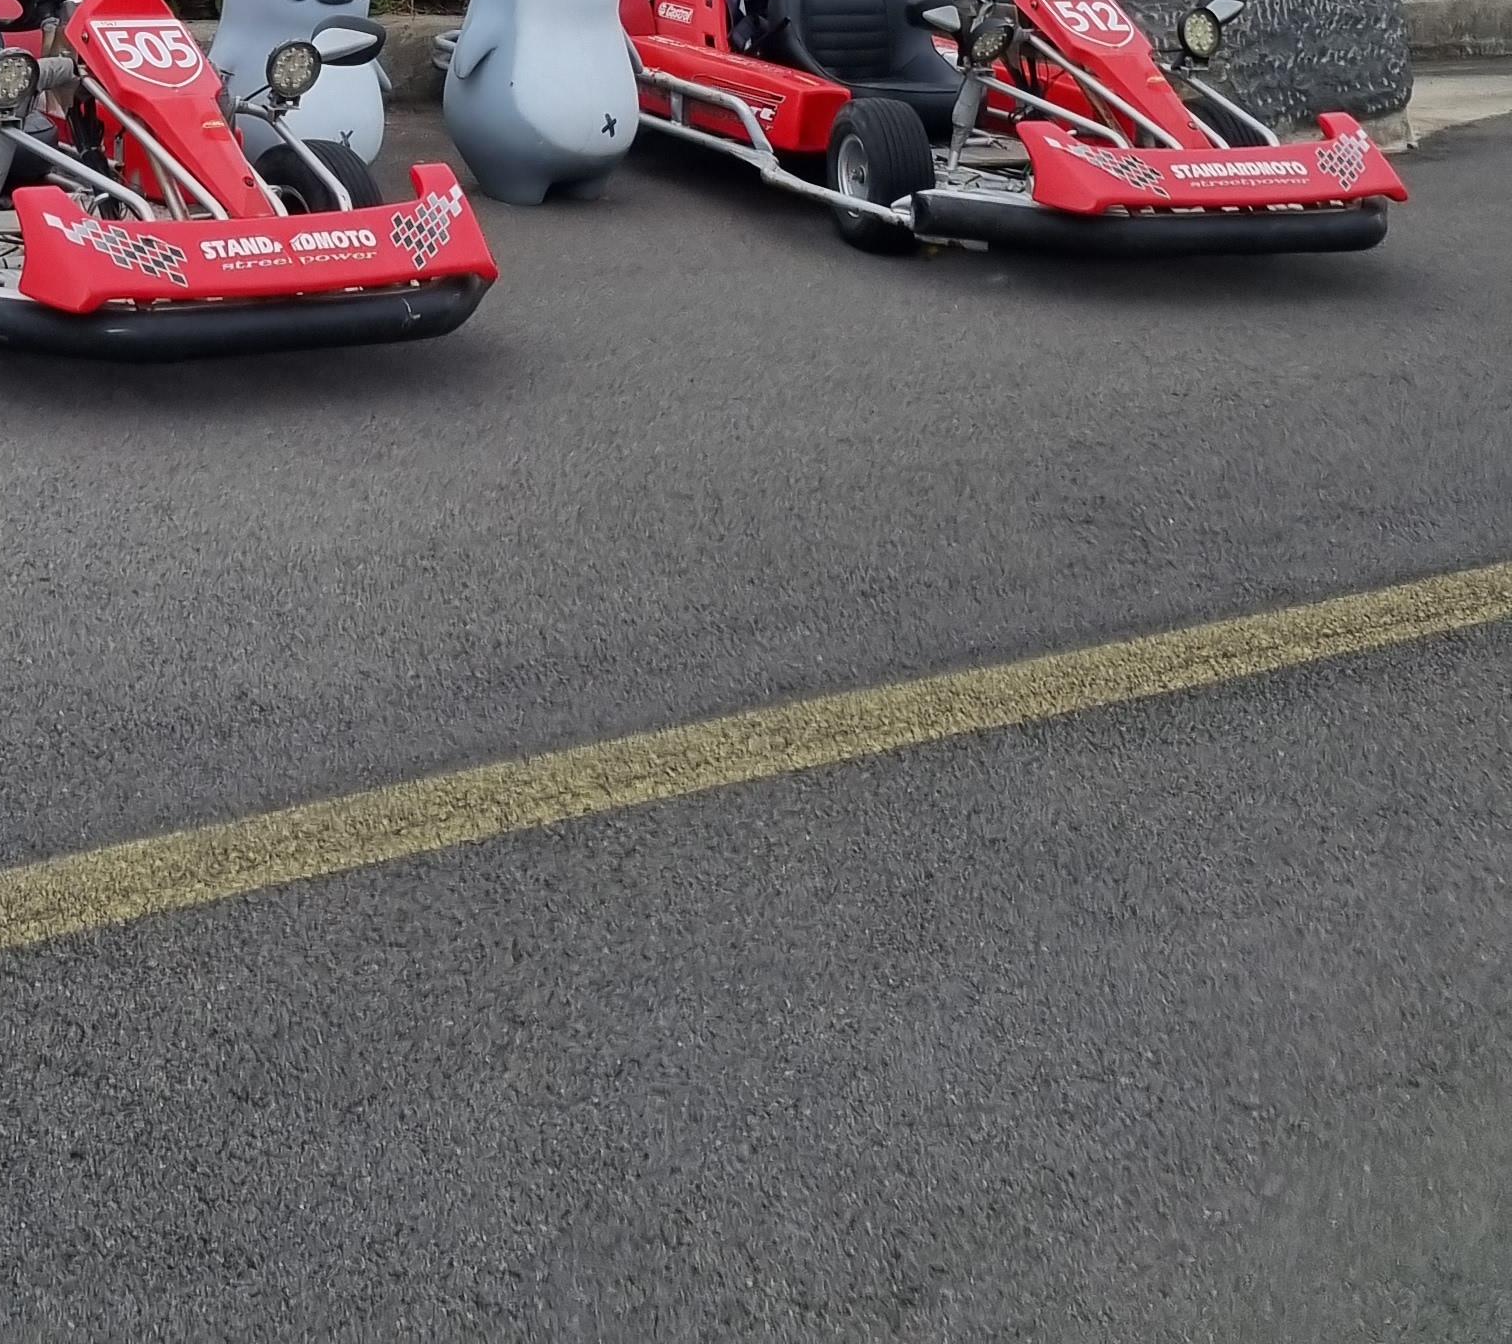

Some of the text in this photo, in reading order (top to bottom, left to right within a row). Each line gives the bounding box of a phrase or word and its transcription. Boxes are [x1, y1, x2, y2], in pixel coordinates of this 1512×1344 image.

[1053, 1, 1131, 32] 512
[105, 30, 198, 69] 505
[1170, 160, 1308, 179] STANDARDMOTO
